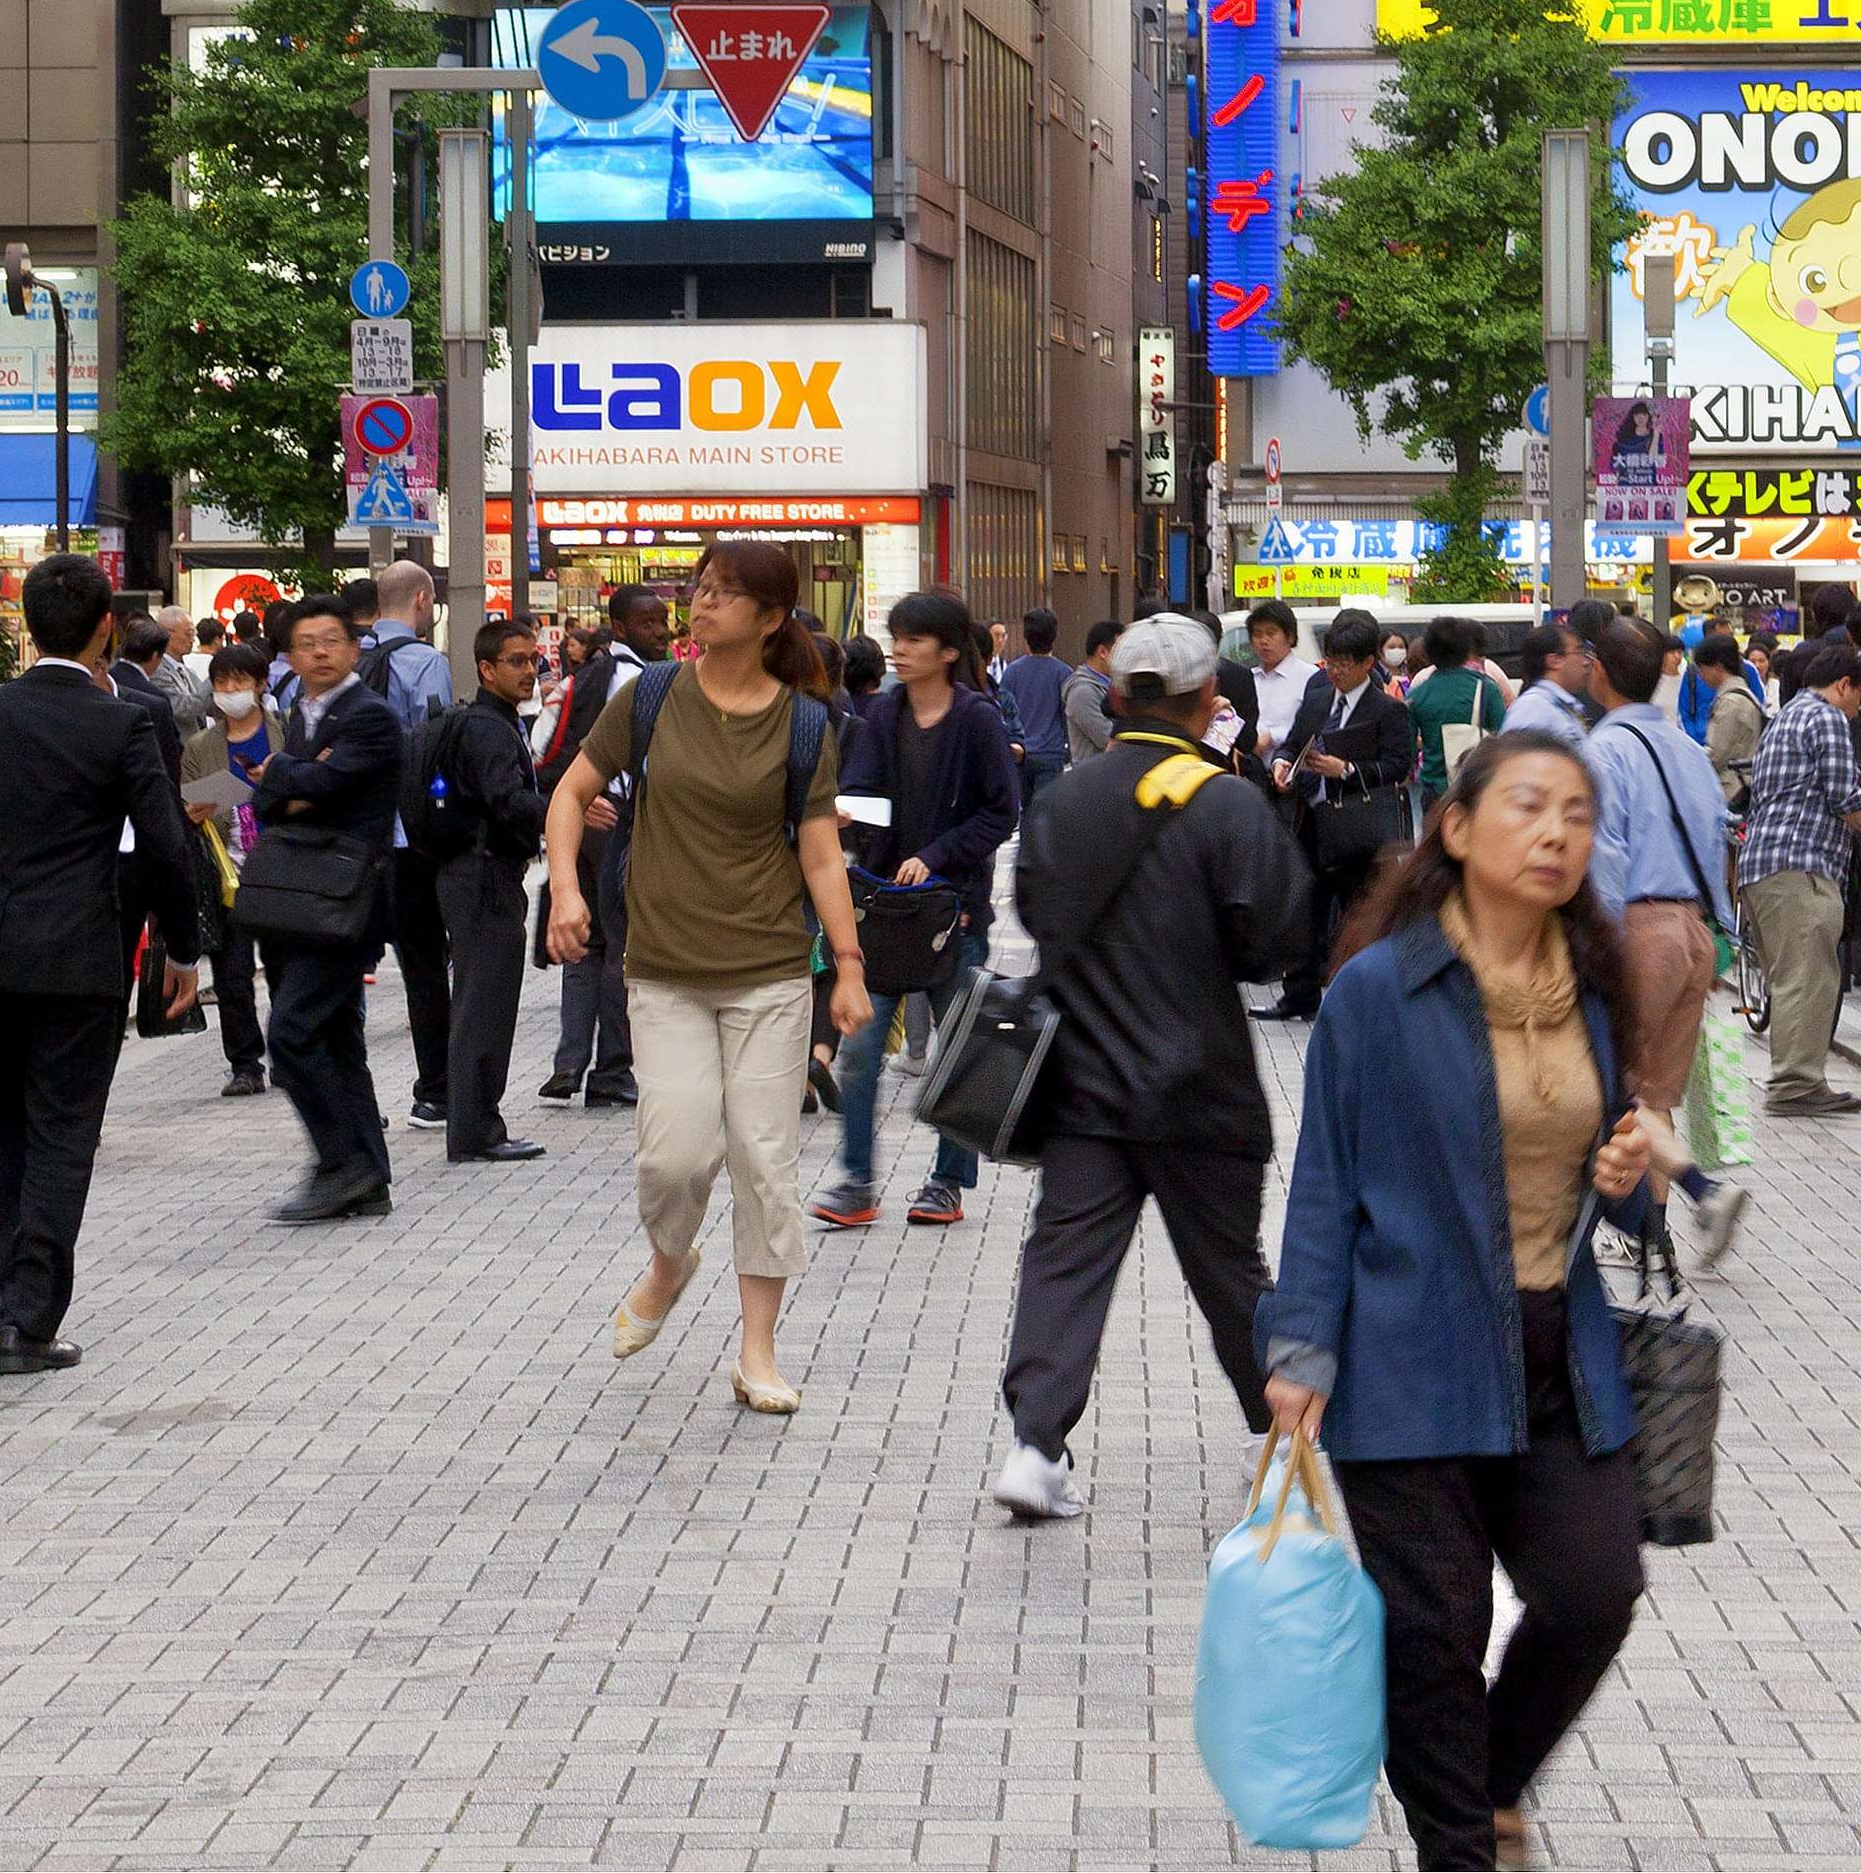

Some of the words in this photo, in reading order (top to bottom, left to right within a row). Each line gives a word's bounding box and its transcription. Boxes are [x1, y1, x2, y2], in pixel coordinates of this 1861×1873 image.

[705, 28, 798, 62] 止まれ
[533, 447, 681, 466] AKIHABARA
[688, 447, 751, 464] MAIN
[760, 446, 845, 464] STORE
[691, 503, 740, 520] DUTY
[739, 503, 784, 520] FREE
[786, 502, 846, 520] STORE
[1747, 586, 1790, 605] ART
